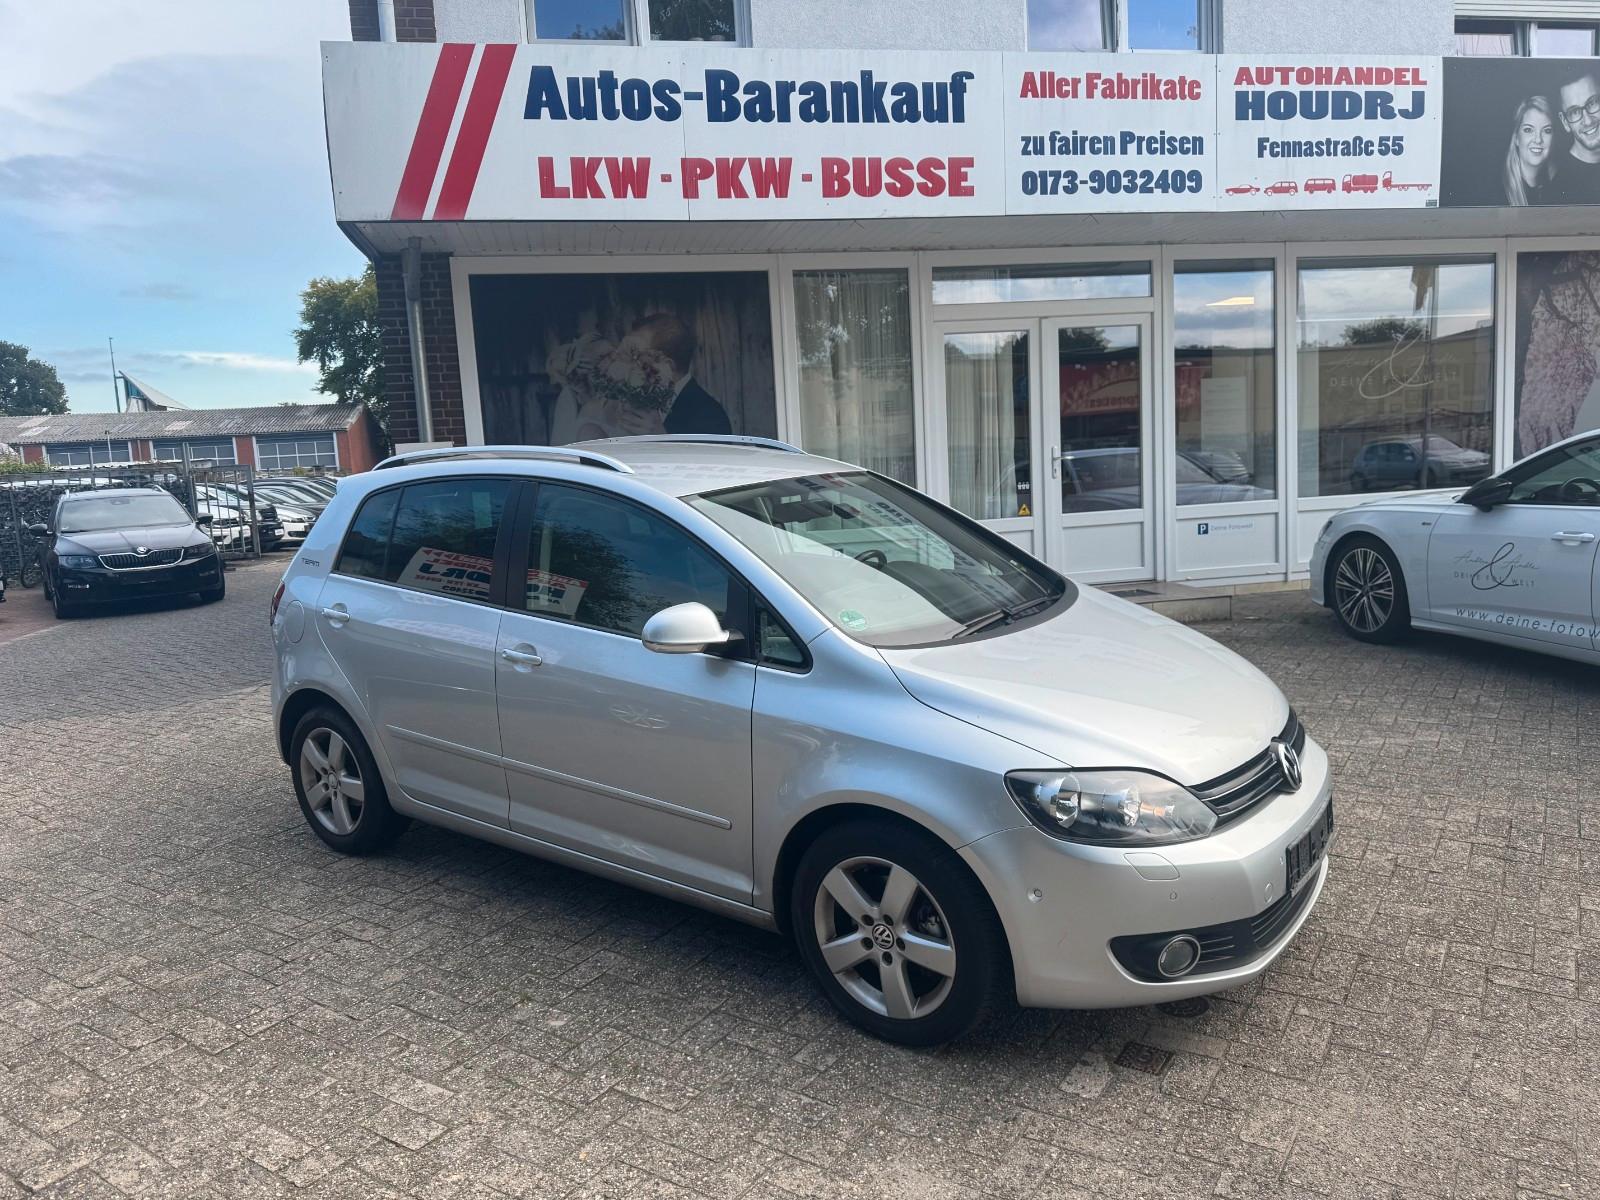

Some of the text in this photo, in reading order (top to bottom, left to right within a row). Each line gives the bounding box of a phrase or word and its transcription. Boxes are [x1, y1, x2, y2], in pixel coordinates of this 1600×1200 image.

[1020, 72, 1201, 100] Aller Fabrikate
[1234, 67, 1427, 86] AUTOHANDEL
[523, 65, 975, 124] Autos-Barankauf
[1235, 90, 1426, 121] HOUDRJ
[1020, 130, 1204, 156] zu fairen Preisen
[1257, 135, 1404, 158] Fennastraße 55
[539, 156, 651, 199] LKW
[681, 157, 793, 199] PKW
[822, 157, 974, 198] BUSSE
[1021, 169, 1203, 196] 0173-9032409
